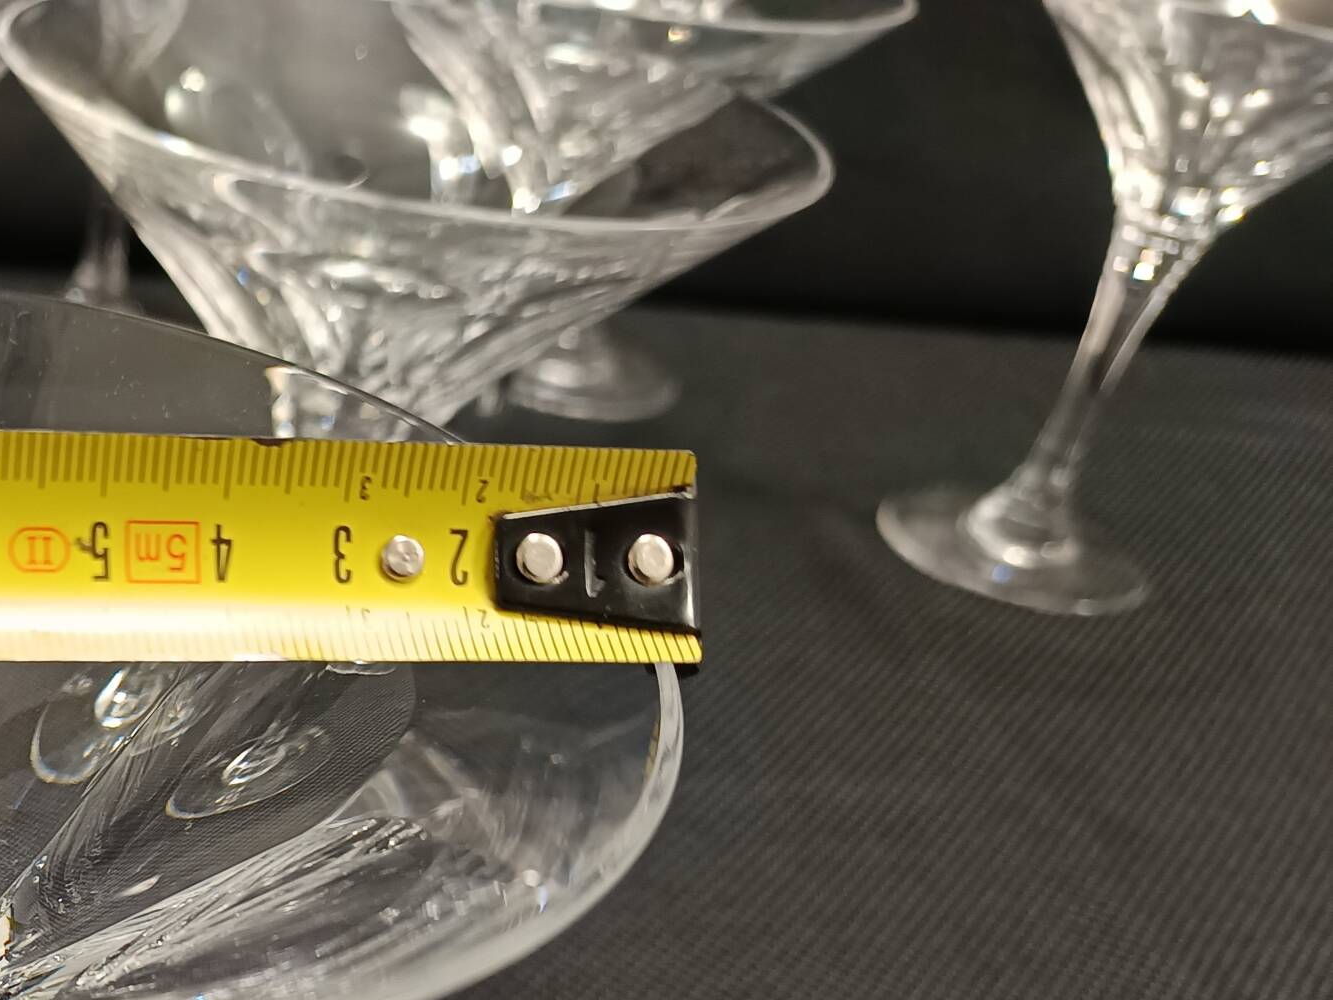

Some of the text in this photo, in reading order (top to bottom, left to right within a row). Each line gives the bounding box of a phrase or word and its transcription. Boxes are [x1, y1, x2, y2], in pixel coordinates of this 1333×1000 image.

[475, 479, 490, 503] 2
[90, 521, 110, 582] 5
[135, 533, 188, 573] 5m
[210, 523, 234, 583] 4
[333, 525, 353, 584] 3
[449, 528, 469, 585] 2
